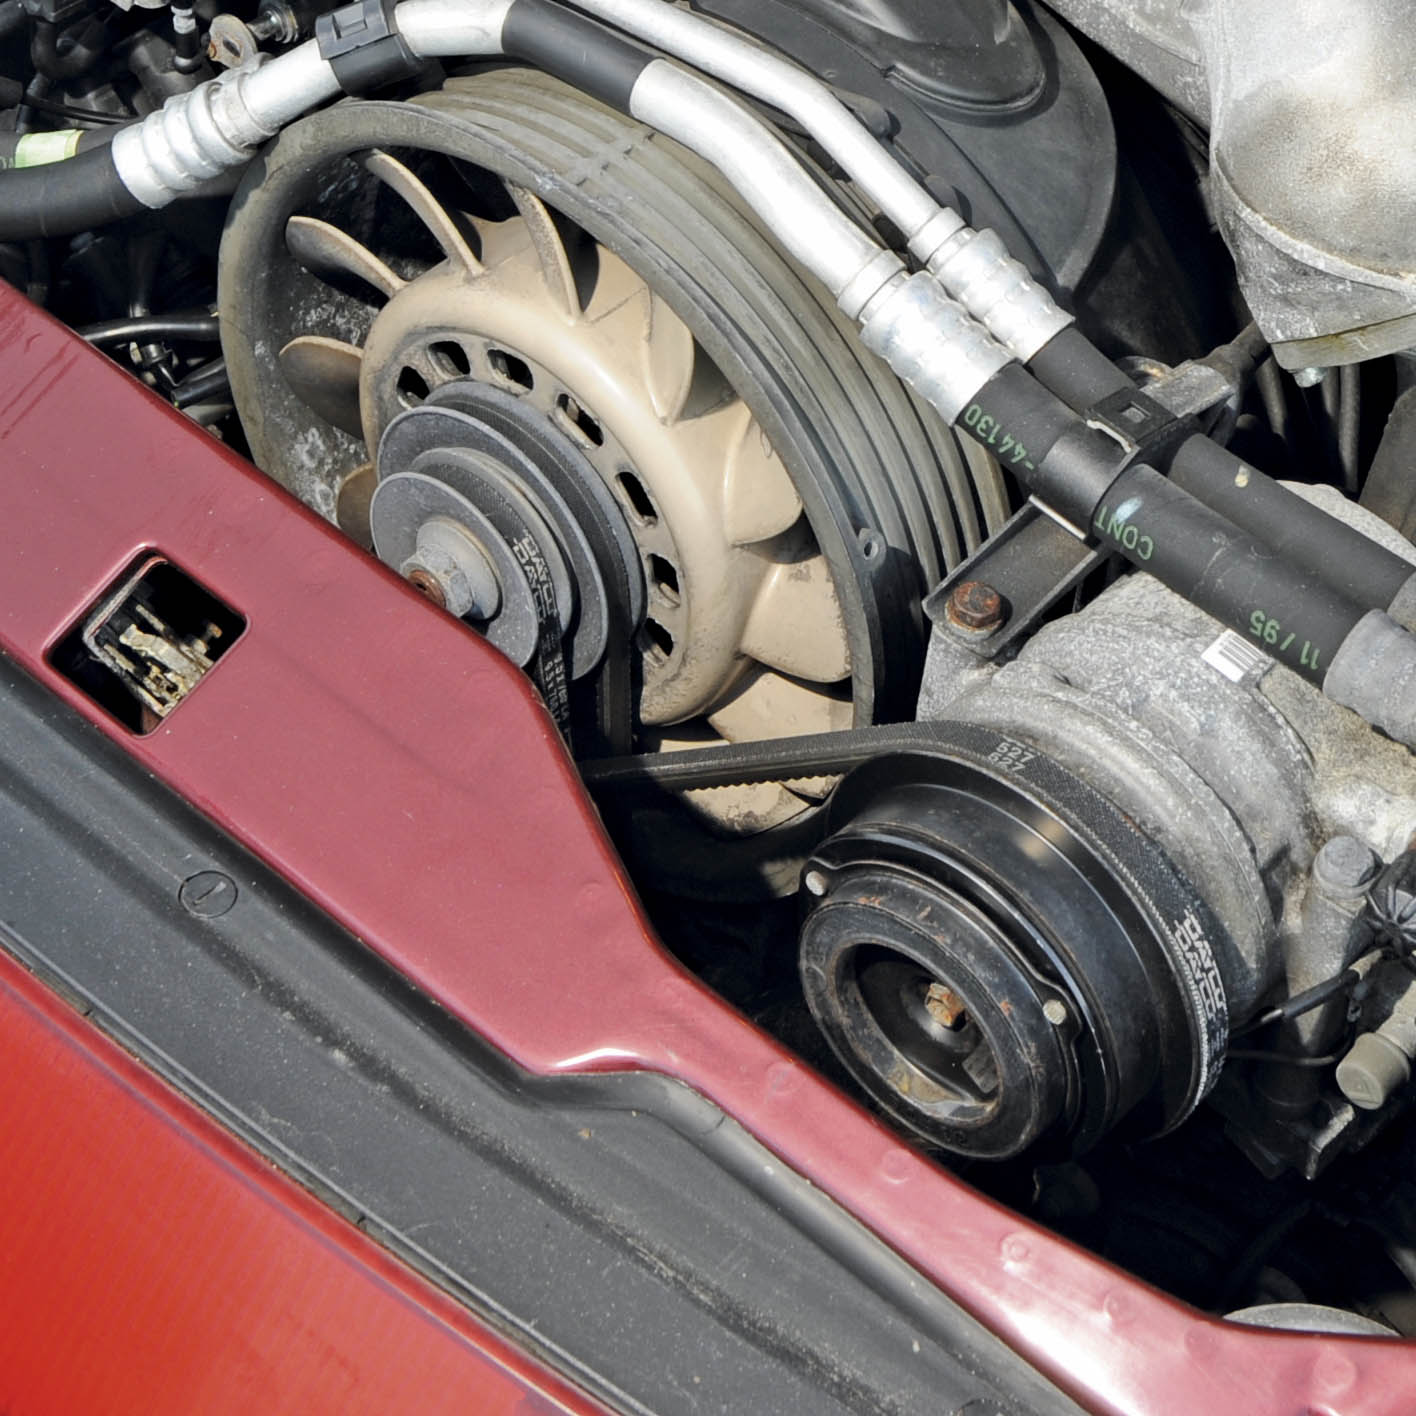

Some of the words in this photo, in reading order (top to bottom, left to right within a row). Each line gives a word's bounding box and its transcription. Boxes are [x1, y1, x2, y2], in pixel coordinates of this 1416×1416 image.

[1094, 504, 1154, 561] CONT
[1173, 919, 1218, 1022] DAYCO
[1183, 904, 1230, 1015] DAYCO
